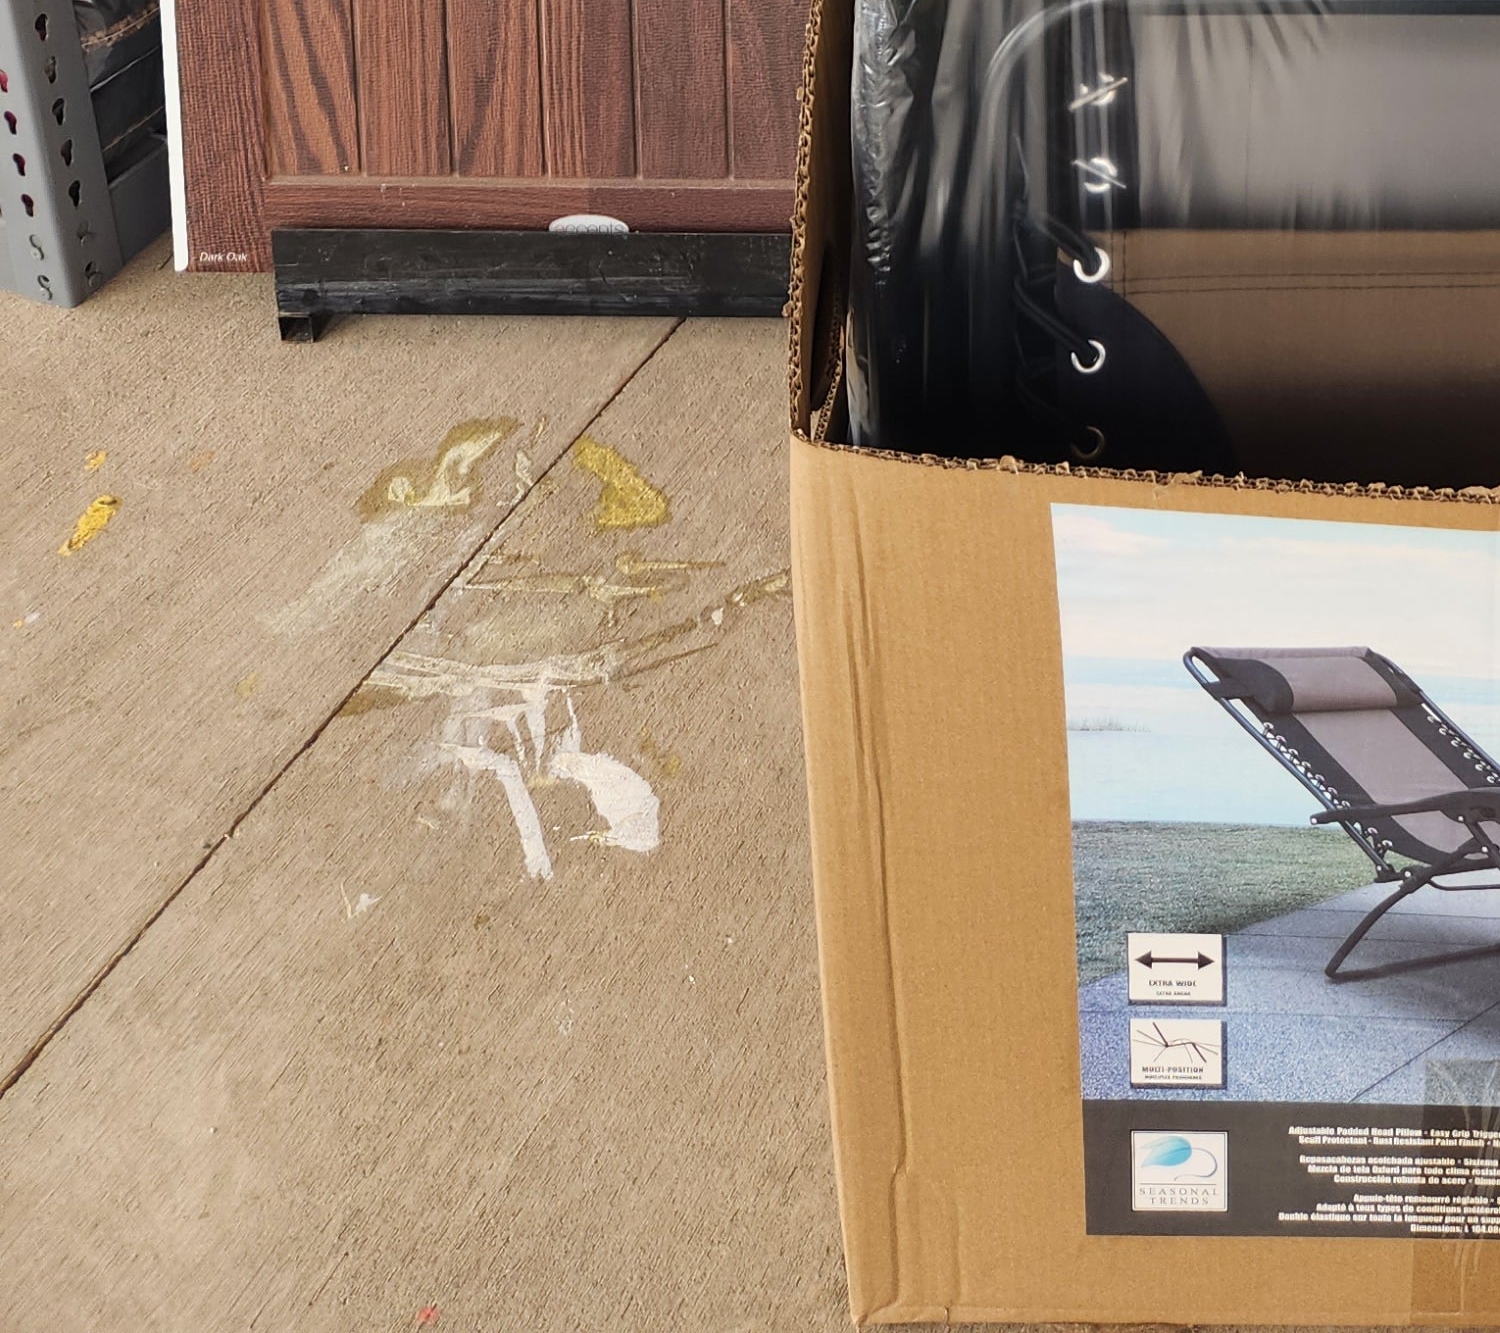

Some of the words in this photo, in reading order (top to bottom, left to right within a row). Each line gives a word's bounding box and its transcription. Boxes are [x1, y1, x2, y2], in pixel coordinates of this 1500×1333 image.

[200, 251, 223, 262] Dark
[226, 252, 248, 262] Oak
[1139, 1188, 1220, 1196] SEASONAL
[1151, 1197, 1209, 1205] TRENDS
